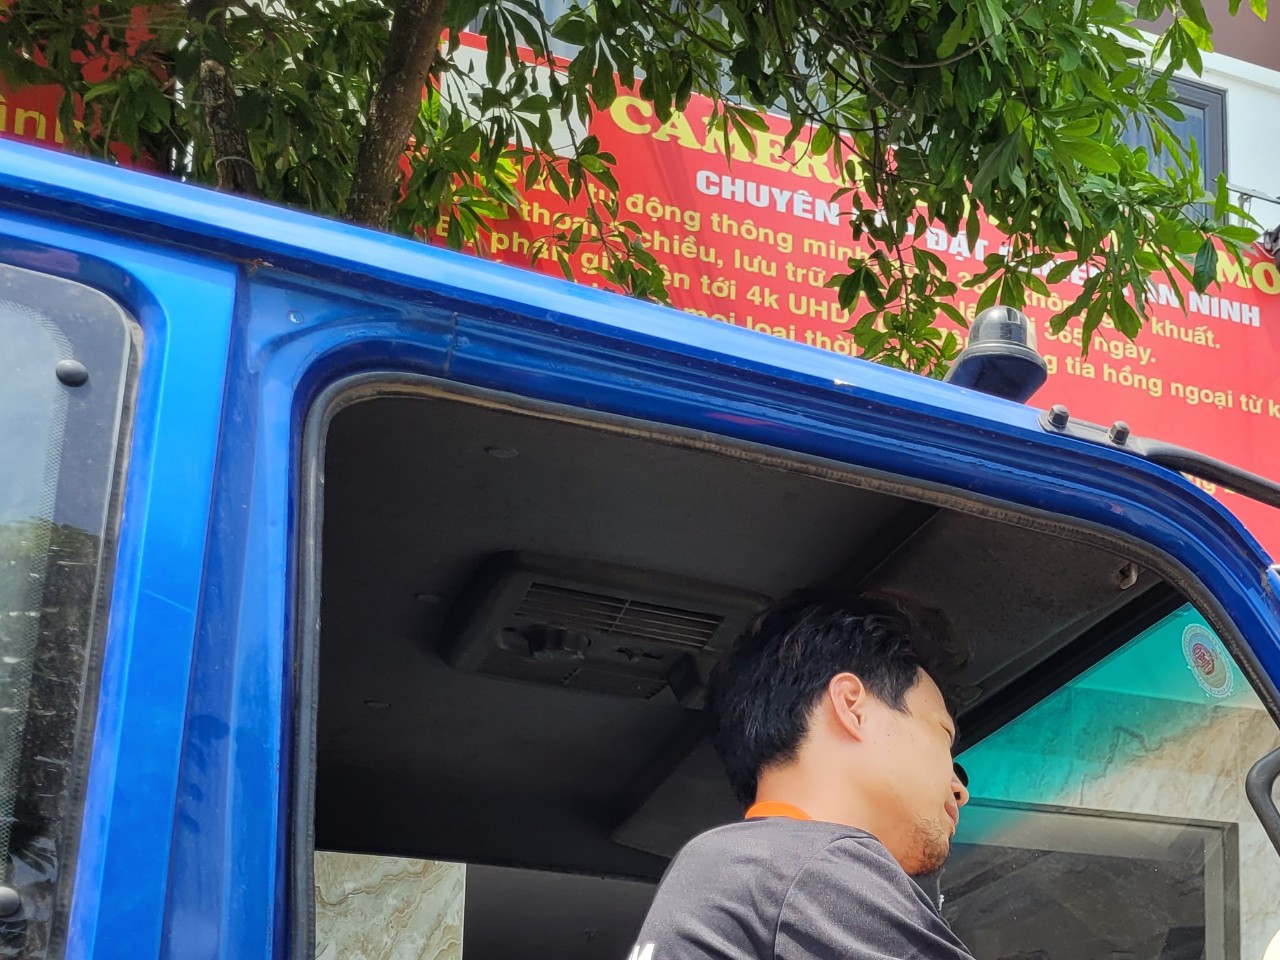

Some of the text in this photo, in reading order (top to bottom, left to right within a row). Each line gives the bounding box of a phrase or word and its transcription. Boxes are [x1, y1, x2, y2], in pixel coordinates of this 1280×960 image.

[625, 193, 701, 232] động
[710, 211, 793, 253] thông
[1151, 317, 1221, 349] khuất.
[639, 230, 724, 268] chiều,
[734, 249, 778, 278] lưu
[785, 261, 826, 289] trữ
[1094, 335, 1157, 364] ngày.
[696, 170, 841, 226] CHUYÊN
[1188, 290, 1261, 327] NINH
[700, 273, 737, 300] tới
[746, 285, 779, 310] 4k
[788, 293, 850, 324] UHD
[1065, 356, 1096, 379] tia
[1102, 362, 1163, 398] hồng
[1169, 381, 1234, 409] ngoại
[1239, 393, 1264, 415] từ
